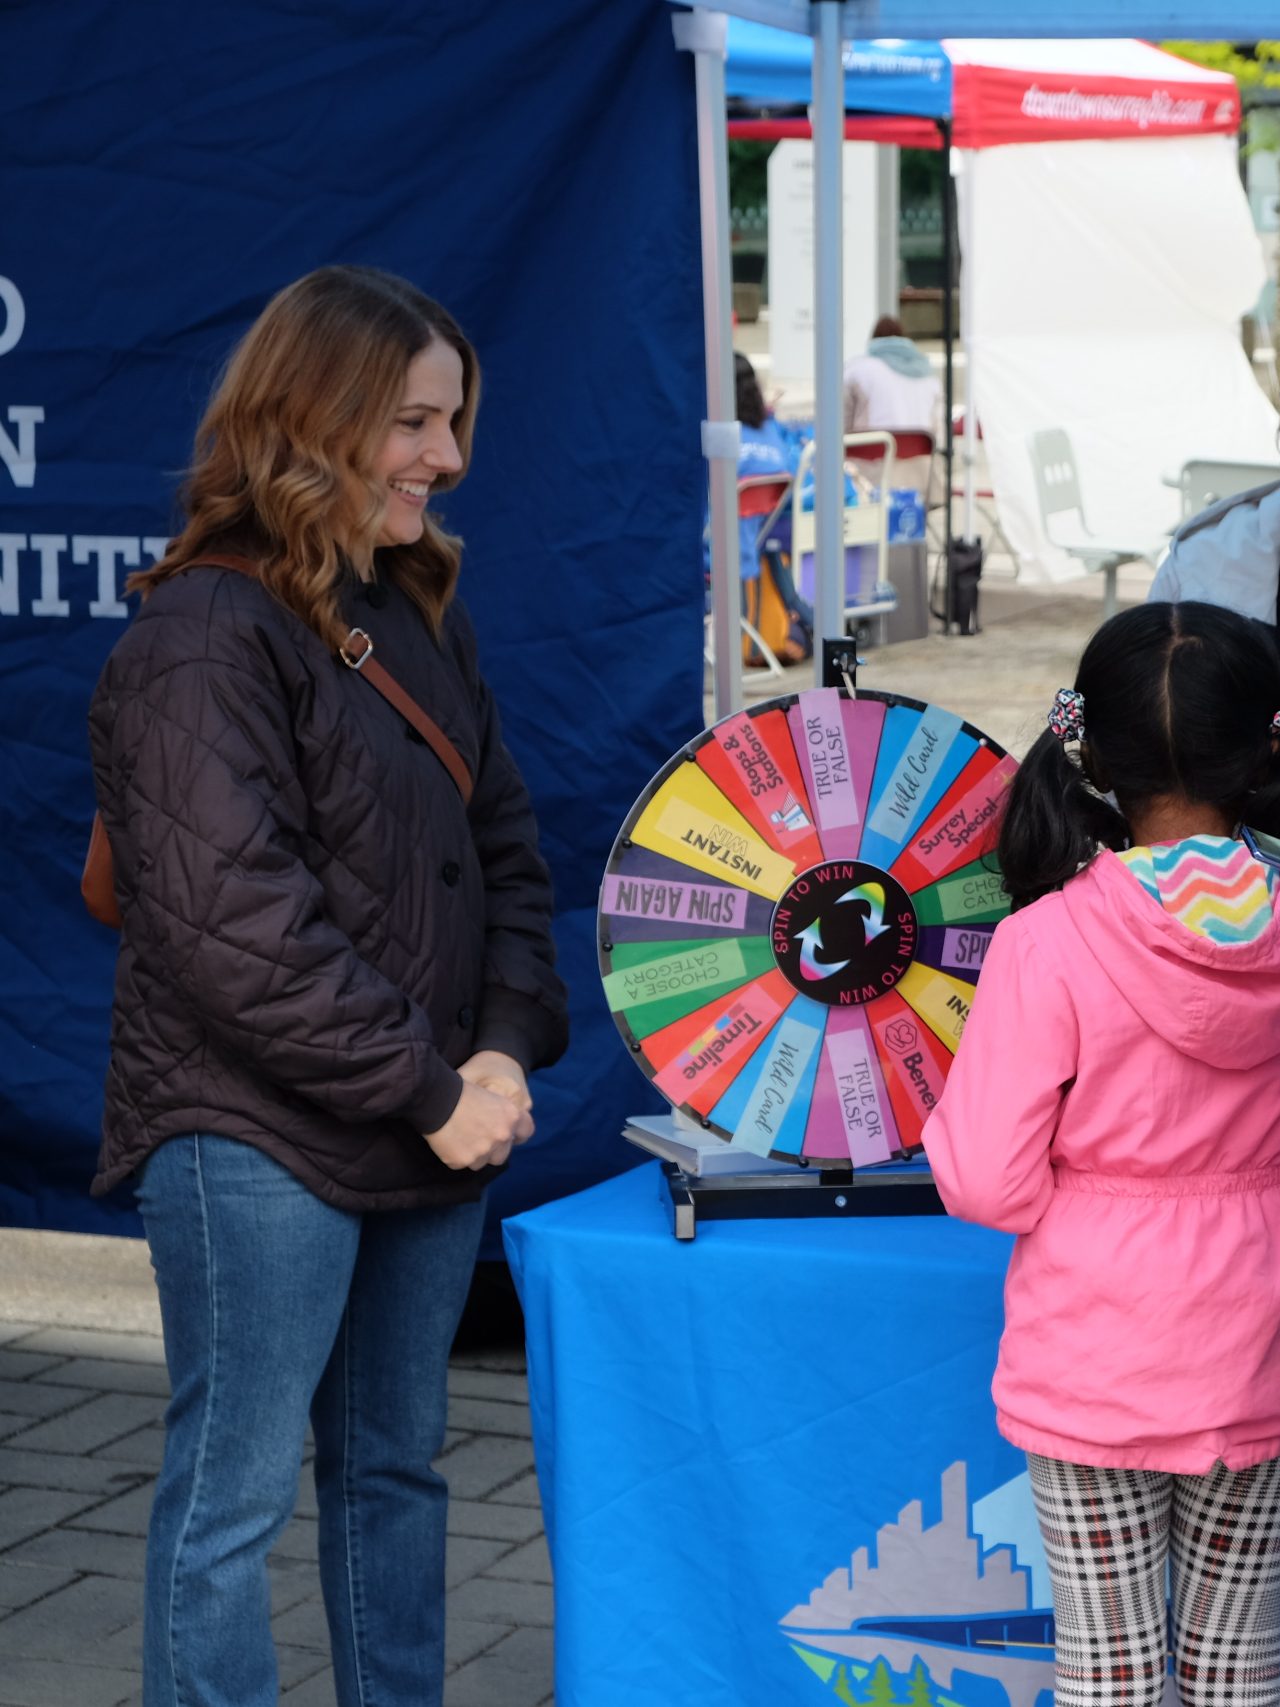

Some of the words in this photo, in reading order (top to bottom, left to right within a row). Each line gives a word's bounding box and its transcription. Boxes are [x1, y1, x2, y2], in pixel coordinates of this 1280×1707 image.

[723, 733, 740, 751] &
[806, 716, 824, 745] OR
[736, 750, 767, 797] Stops
[740, 724, 783, 789] Stations
[812, 750, 832, 800] TRUE
[826, 726, 848, 784] FALSE
[889, 773, 920, 819] Wild
[907, 726, 939, 774] Card
[709, 824, 748, 856] WIN
[918, 808, 967, 855] Surrey
[948, 796, 999, 848] Special
[681, 829, 762, 881] INSTANT
[615, 880, 683, 918] AGAIN
[687, 889, 736, 923] SPIN
[774, 908, 792, 953] SPIN
[786, 881, 810, 902] TO
[815, 865, 853, 884] WIN
[962, 876, 1004, 896] CHO
[898, 912, 913, 957] SPIN
[623, 951, 718, 988] CATEGORY
[646, 966, 720, 997] CHOOSE
[881, 964, 904, 986] TO
[627, 988, 639, 1000] A
[839, 984, 878, 1004] WIN
[682, 1012, 762, 1080] Timeline
[770, 1042, 799, 1088] Wild
[755, 1087, 785, 1135] Card
[838, 1074, 863, 1130] FALSE
[853, 1058, 875, 1106] TRUE
[864, 1110, 882, 1138] OR
